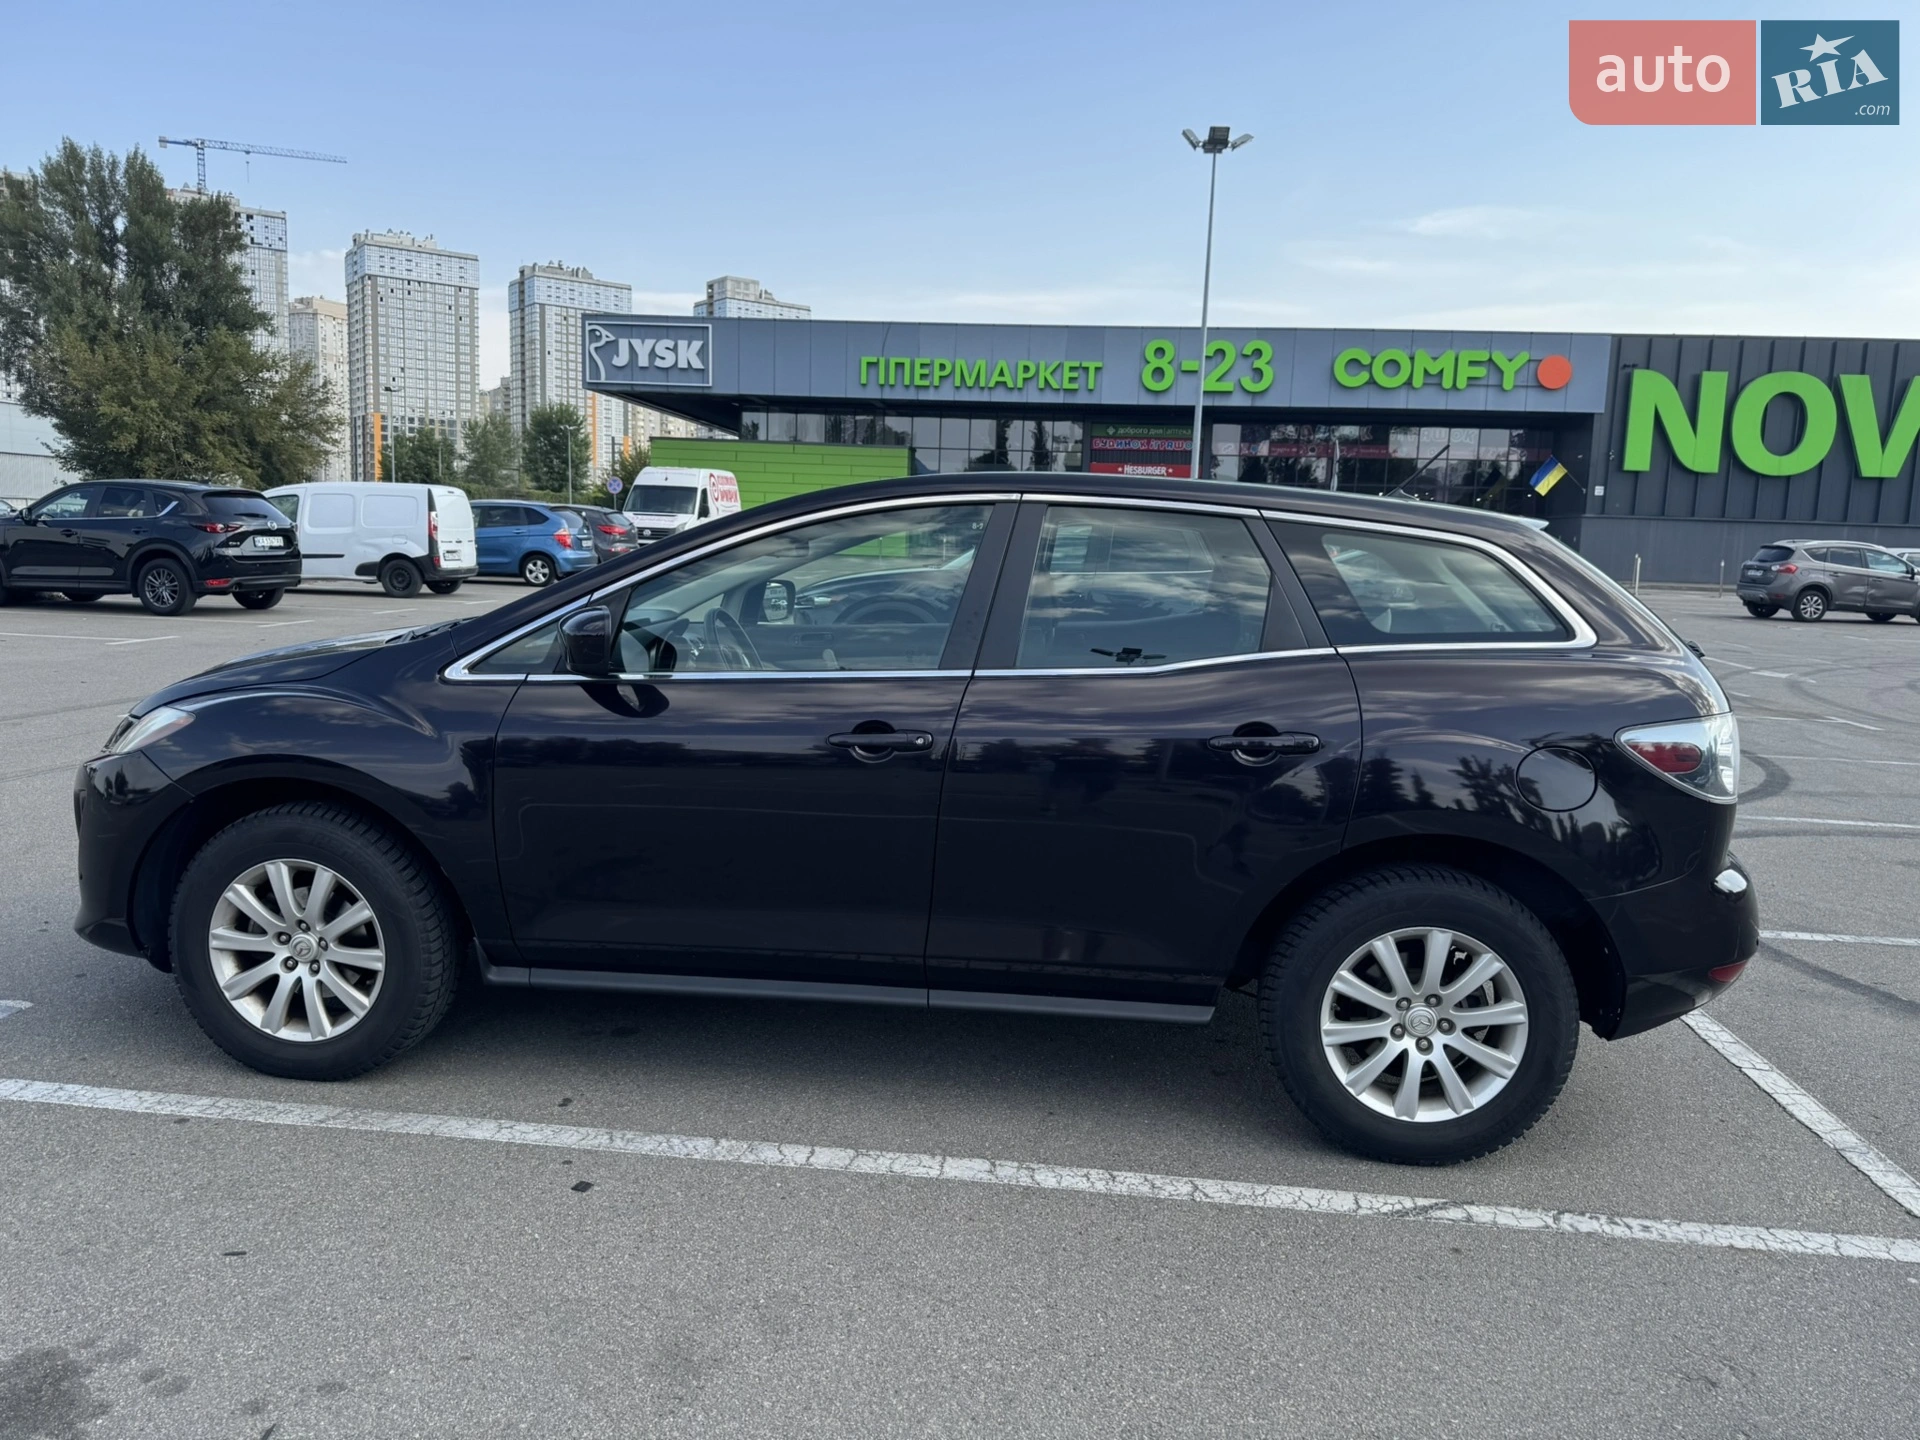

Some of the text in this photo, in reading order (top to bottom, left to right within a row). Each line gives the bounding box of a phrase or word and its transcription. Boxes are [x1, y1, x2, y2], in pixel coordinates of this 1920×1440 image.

[611, 338, 705, 370] JYSK
[859, 339, 1275, 393] ГІПЕРМАРКЕТ 8-23
[1333, 347, 1530, 391] COMFY
[1623, 369, 1920, 478] NOV
[1150, 441, 1192, 451] іГРАШО
